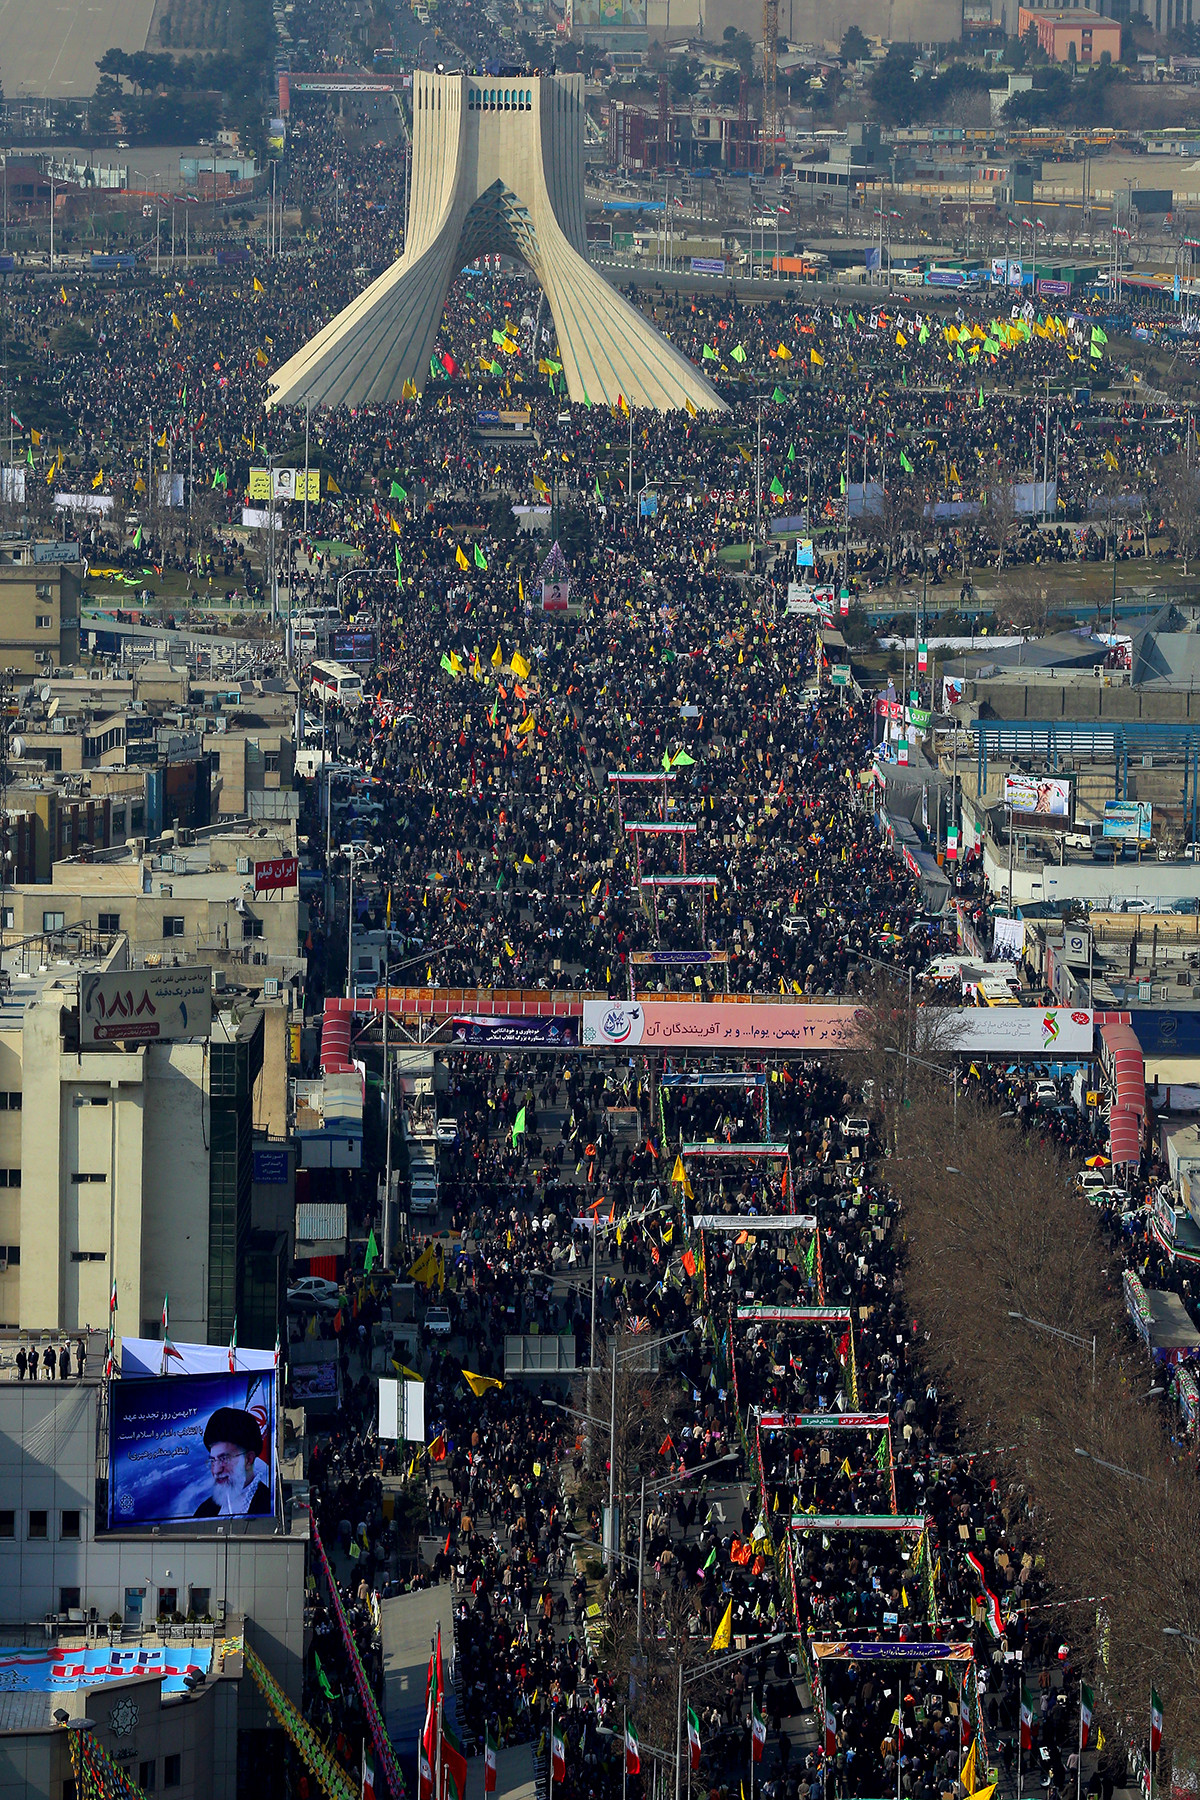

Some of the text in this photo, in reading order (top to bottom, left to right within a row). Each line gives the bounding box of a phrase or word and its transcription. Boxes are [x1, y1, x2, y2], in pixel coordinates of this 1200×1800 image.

[257, 861, 296, 880] ایران فیلم
[192, 986, 205, 994] فقط
[97, 989, 156, 1019] ۱۸۱۸
[646, 1021, 660, 1036] آن
[663, 1022, 720, 1038] آفرینندگان
[723, 1028, 732, 1038] بر
[803, 1026, 816, 1036] ۲۲
[819, 1030, 828, 1040] بر
[138, 1411, 160, 1421] تجدید
[160, 1412, 171, 1421] روز
[136, 1430, 155, 1440] اسلام
[110, 1651, 162, 1665] ۲۲
